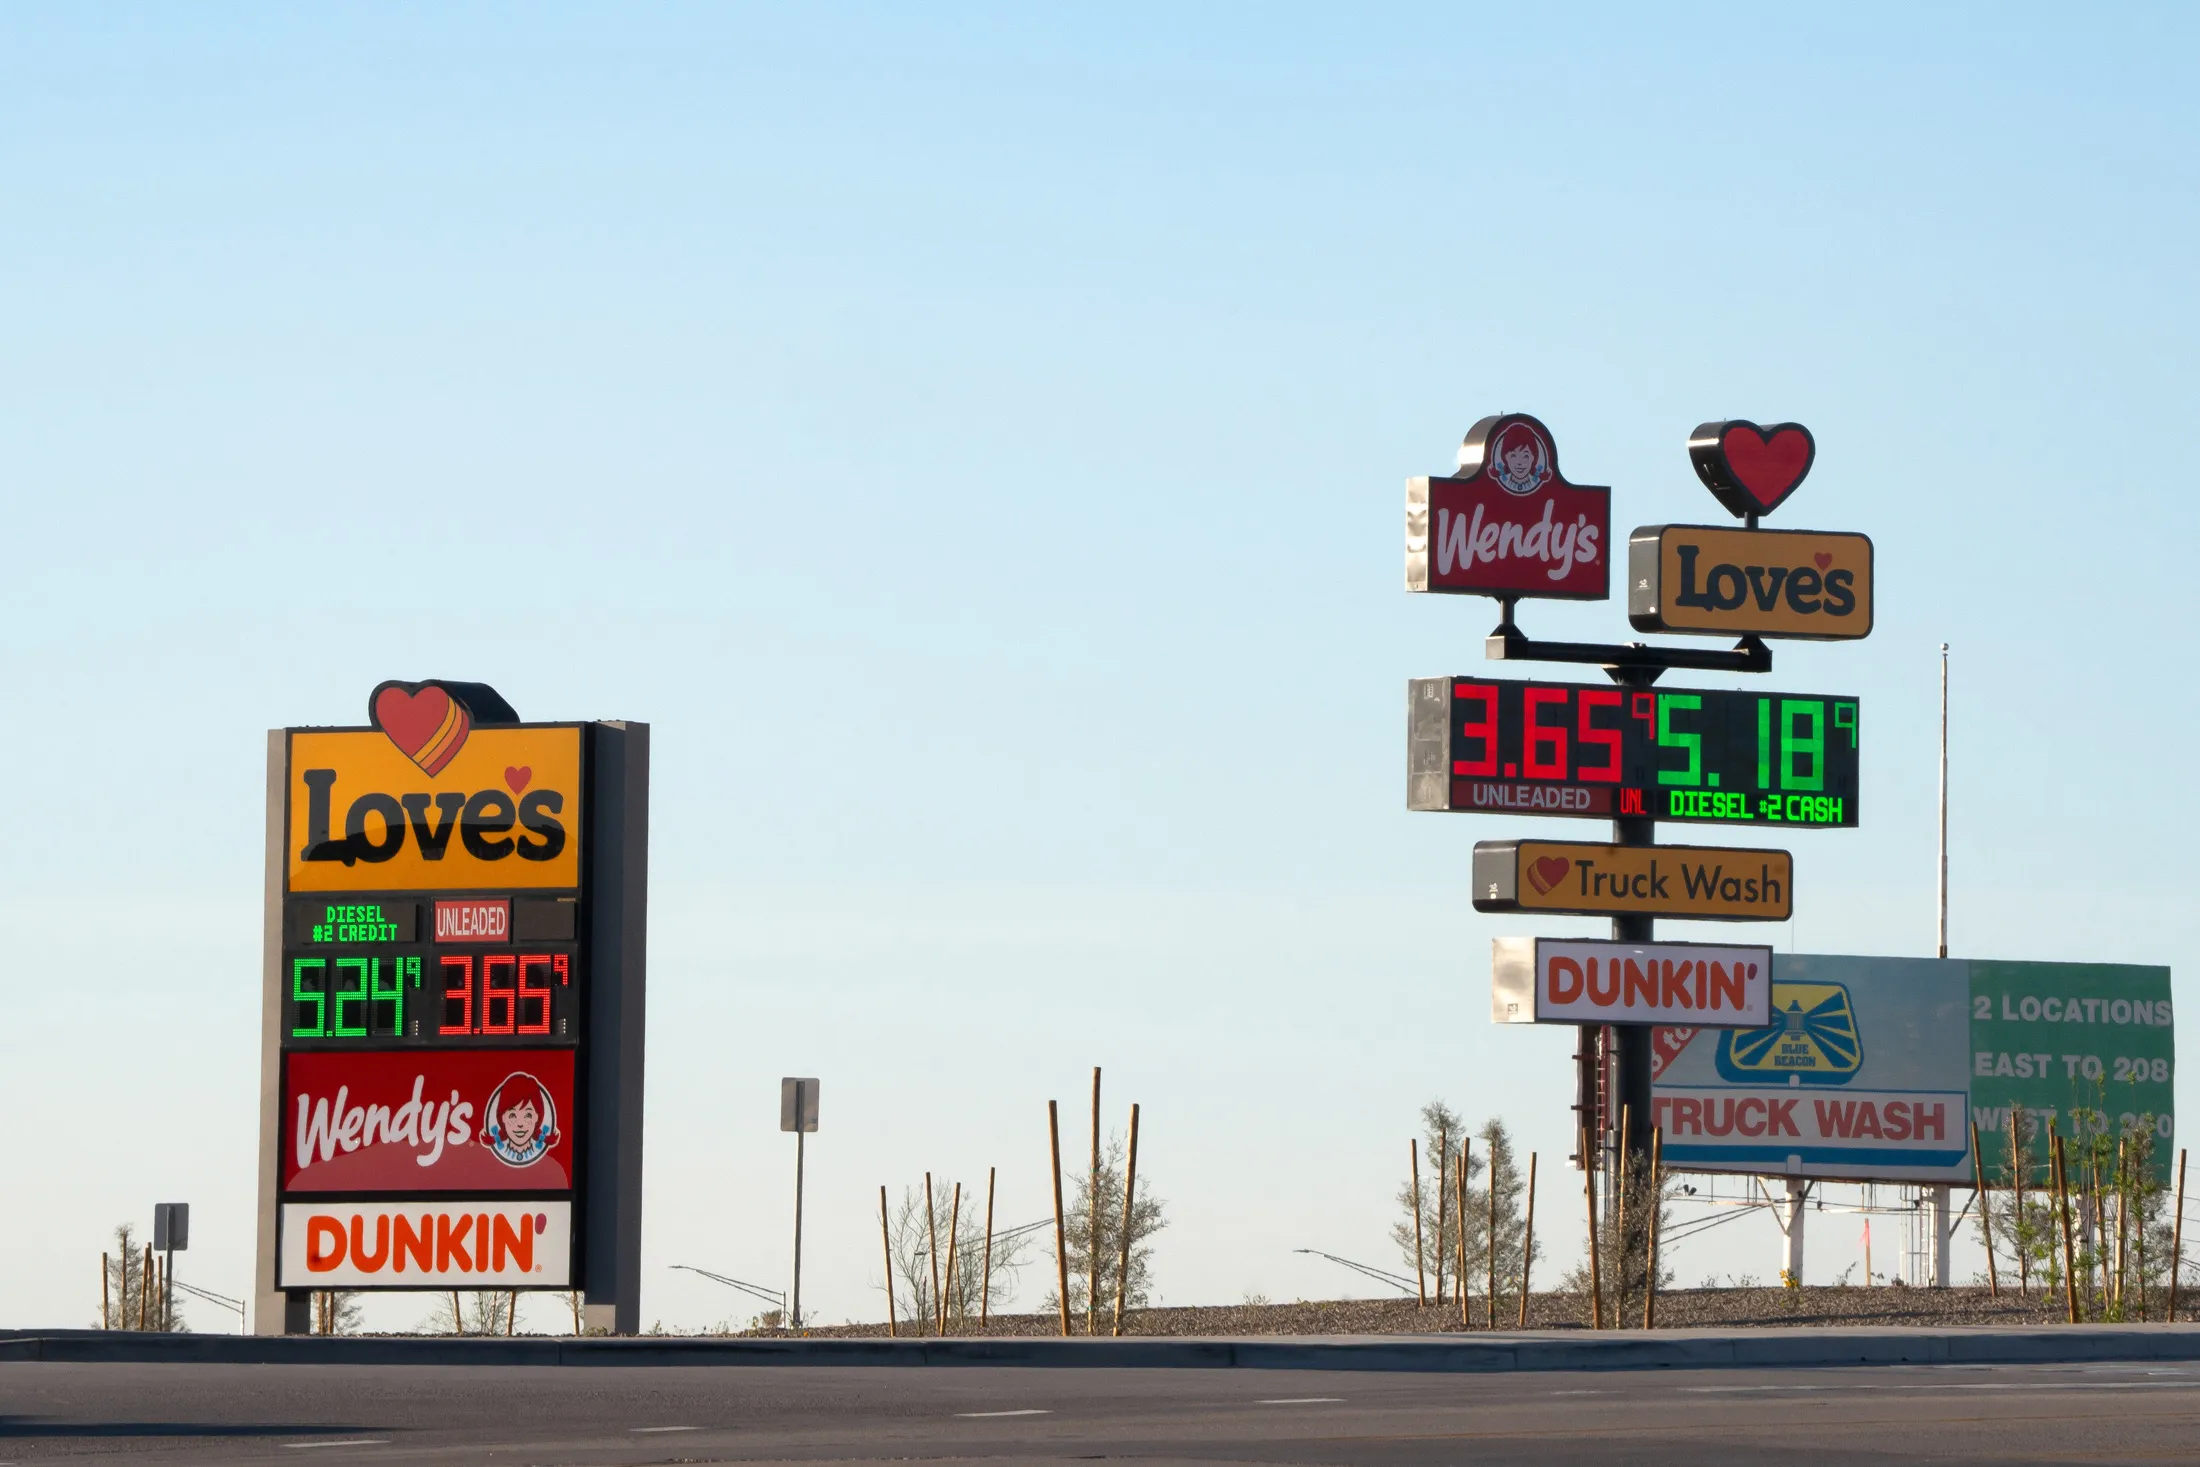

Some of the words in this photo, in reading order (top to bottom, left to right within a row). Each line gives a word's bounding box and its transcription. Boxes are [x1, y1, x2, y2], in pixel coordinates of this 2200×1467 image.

[1437, 499, 1599, 581] Wendy's
[1473, 783, 1591, 810] UNLEADED
[1620, 788, 1648, 815] UNL
[1670, 790, 1754, 819] DIESEL
[1758, 794, 1782, 820] #2
[1786, 795, 1842, 823] CASH
[1575, 860, 1670, 899] Truck
[1680, 864, 1781, 904] Wash
[326, 905, 385, 923] DIESEL
[437, 906, 506, 937] UNLEADED
[312, 924, 334, 942] #2
[338, 924, 398, 942] CREDIT
[1549, 956, 1758, 1012] DUNKIN'
[1973, 995, 1993, 1021] 2
[2002, 995, 2174, 1027] LOCATIONS
[1774, 1056, 1816, 1067] BEACON
[1781, 1043, 1809, 1055] BLUE
[1974, 1051, 2052, 1079] EAST
[2061, 1054, 2103, 1082] TO
[2113, 1056, 2169, 1084] 208
[297, 1074, 474, 1169] Wendy's
[1651, 1097, 1801, 1137] TRUCK
[1814, 1100, 1945, 1140] WASH
[307, 1213, 547, 1273] DUNKIN'
